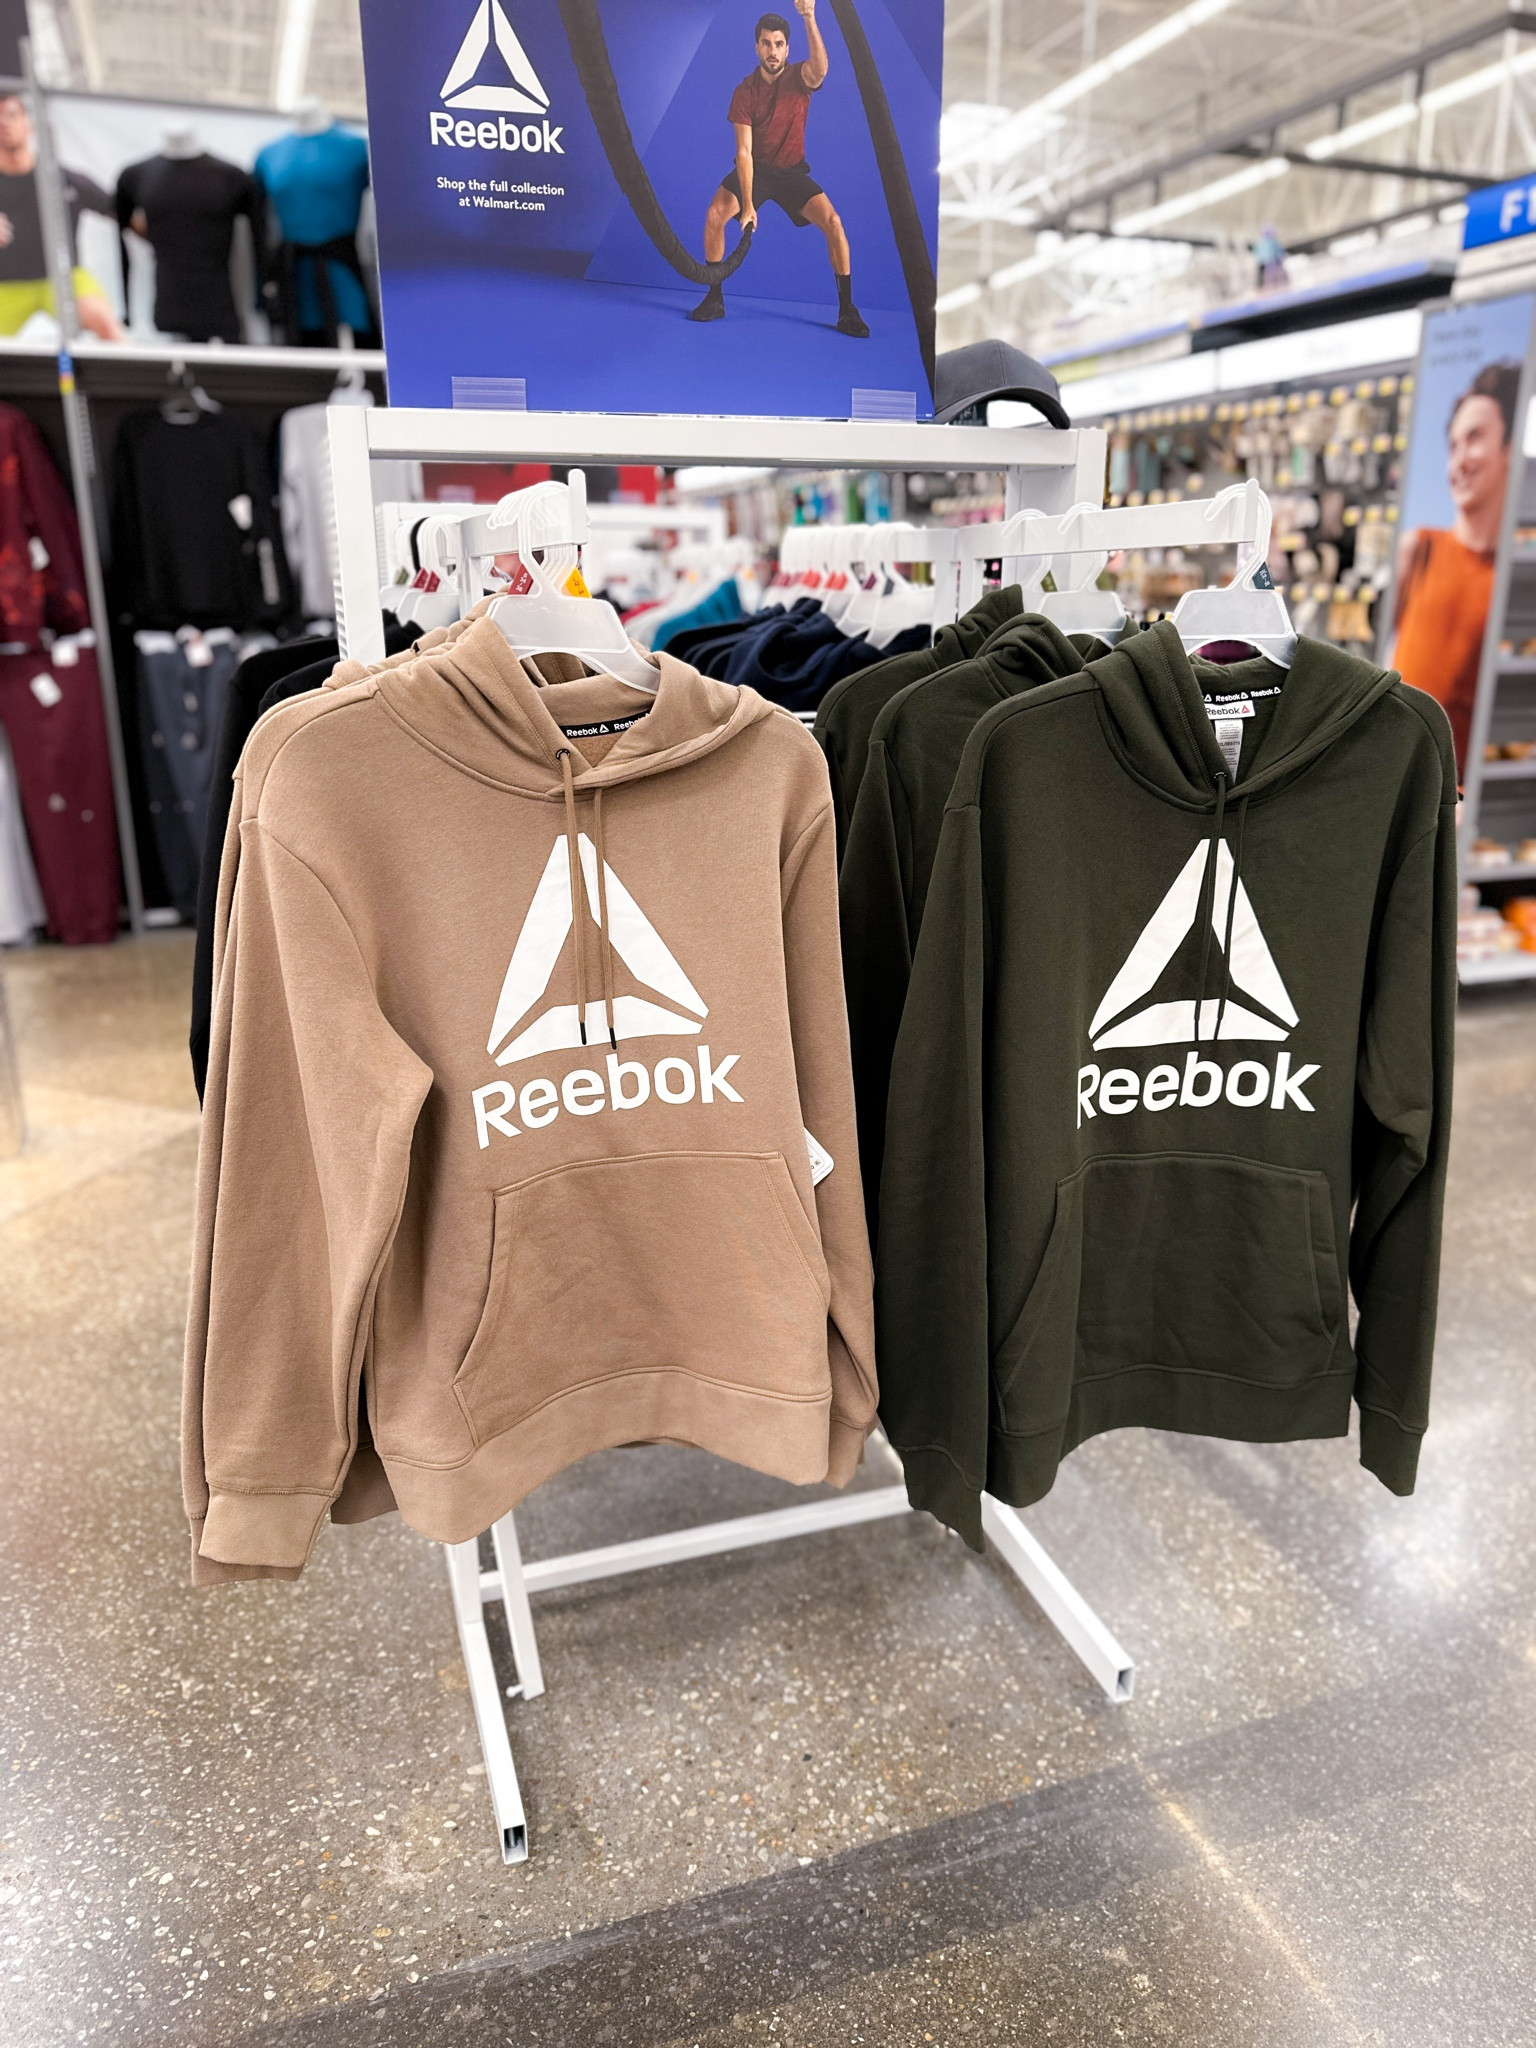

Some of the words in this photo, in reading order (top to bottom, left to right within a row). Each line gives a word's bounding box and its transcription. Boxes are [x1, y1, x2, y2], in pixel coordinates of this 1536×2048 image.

[430, 111, 565, 154] Reebok
[436, 176, 466, 192] Shop
[468, 179, 487, 191] the
[490, 180, 508, 192] full
[510, 182, 565, 196] collection
[458, 197, 471, 207] at
[472, 195, 545, 211] Walmart.com
[1215, 694, 1241, 702] Reebok
[1250, 689, 1273, 697] Reebok
[1206, 707, 1240, 715] Reebok
[566, 727, 598, 737] Reebok
[614, 718, 640, 730] Reeb
[471, 1045, 745, 1150] Reebok
[1077, 1051, 1322, 1130] Reebok
